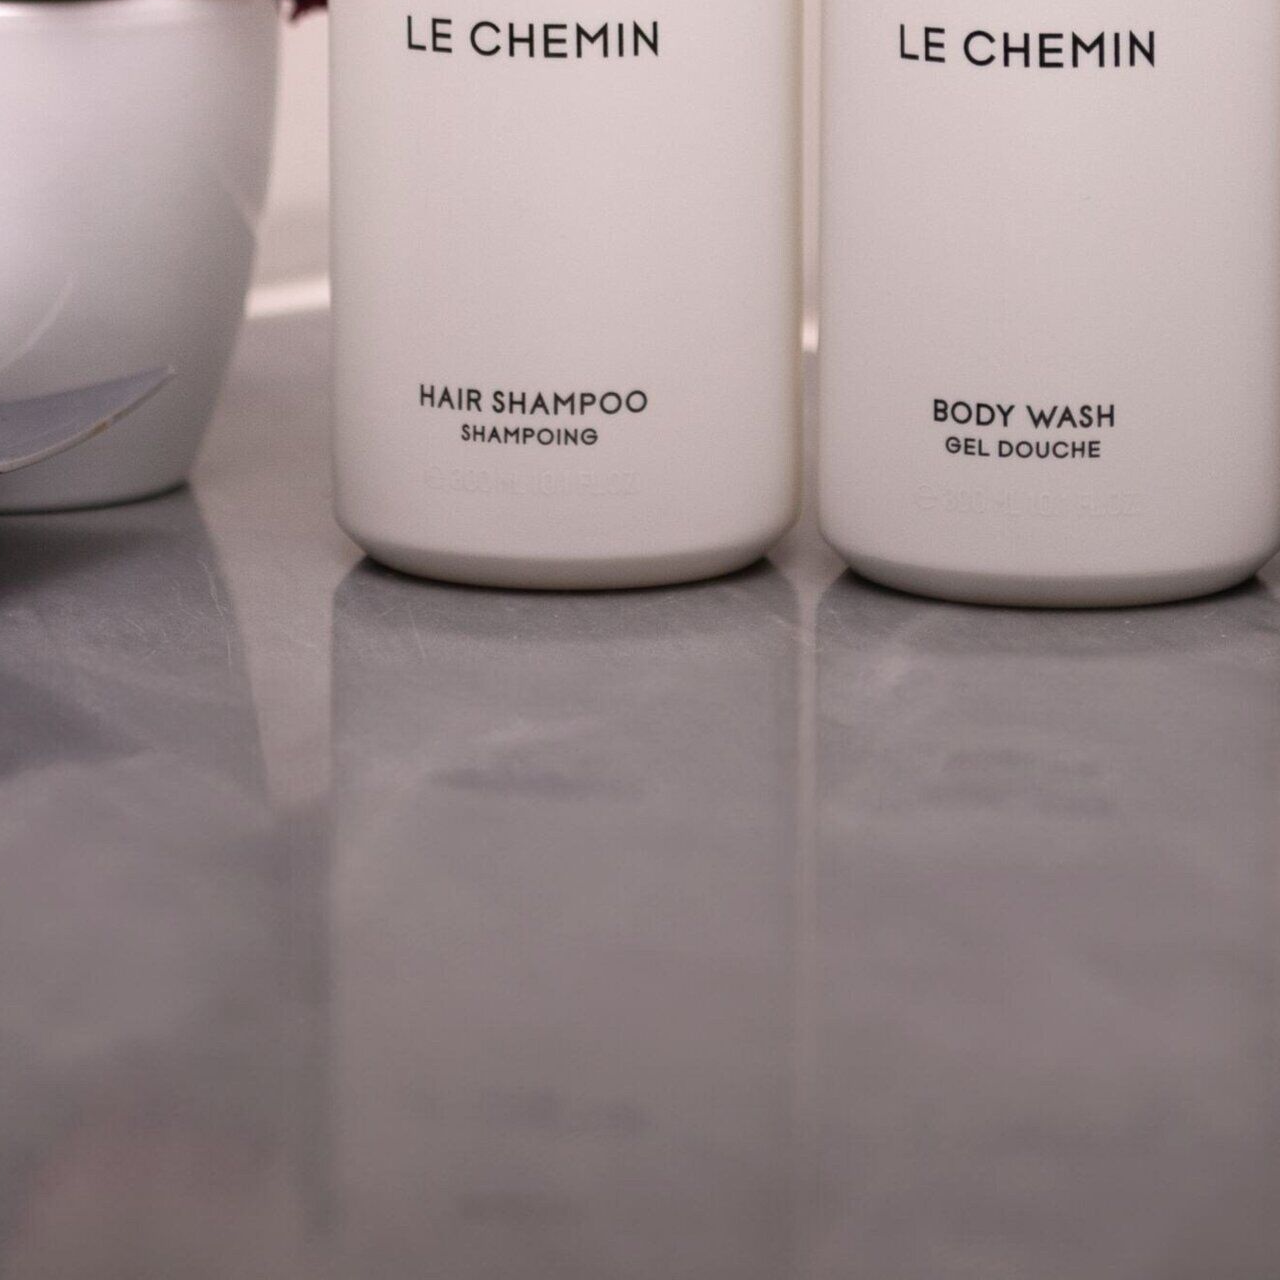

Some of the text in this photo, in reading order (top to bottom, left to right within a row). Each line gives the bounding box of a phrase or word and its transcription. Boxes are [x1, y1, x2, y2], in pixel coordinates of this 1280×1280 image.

[406, 15, 660, 59] LE CHEMIN
[898, 23, 1156, 69] LE CHEMIN
[419, 383, 649, 416] HAIR SHAMPOO
[932, 398, 1116, 429] BODY WASH
[460, 422, 600, 447] SHAMPOING
[944, 435, 1102, 460] GEL DOUCHE
